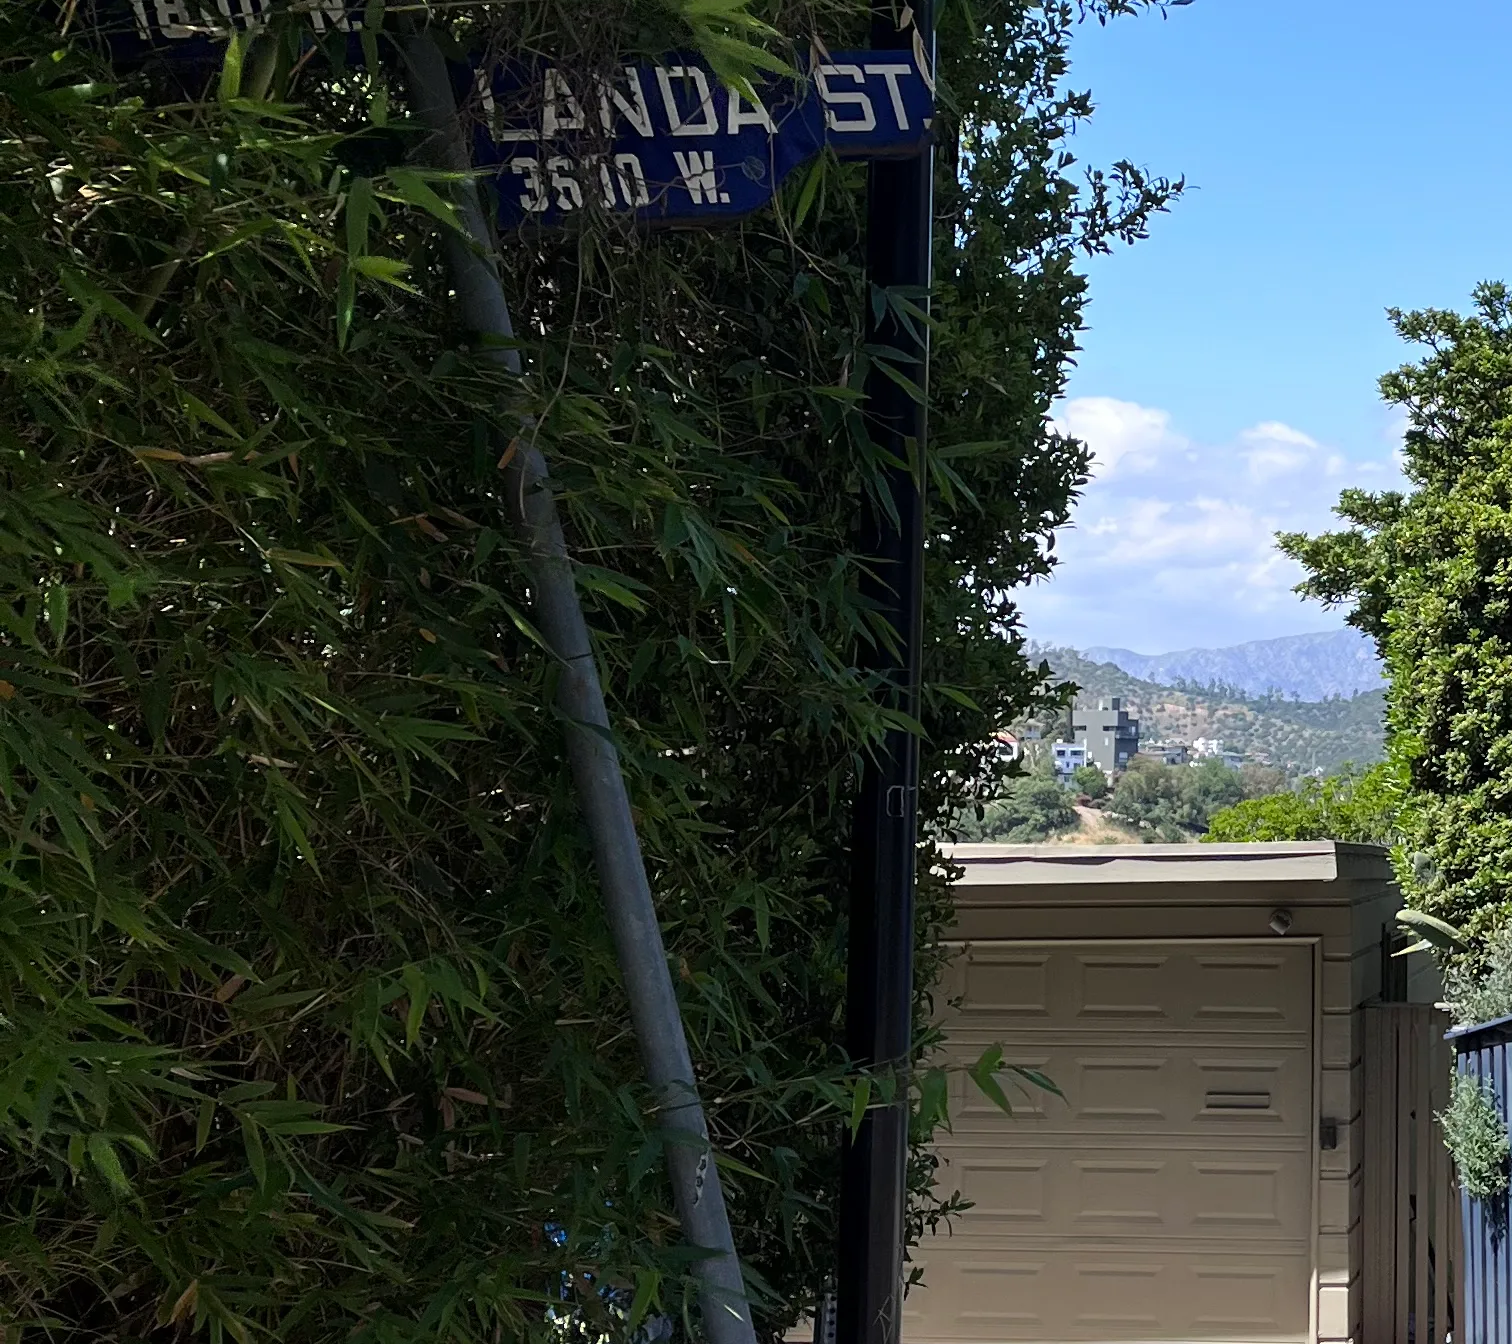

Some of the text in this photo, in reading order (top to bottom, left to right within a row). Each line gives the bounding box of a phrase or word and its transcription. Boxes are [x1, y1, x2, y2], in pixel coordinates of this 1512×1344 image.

[474, 64, 932, 141] LANDA ST.
[673, 151, 730, 204] W.
